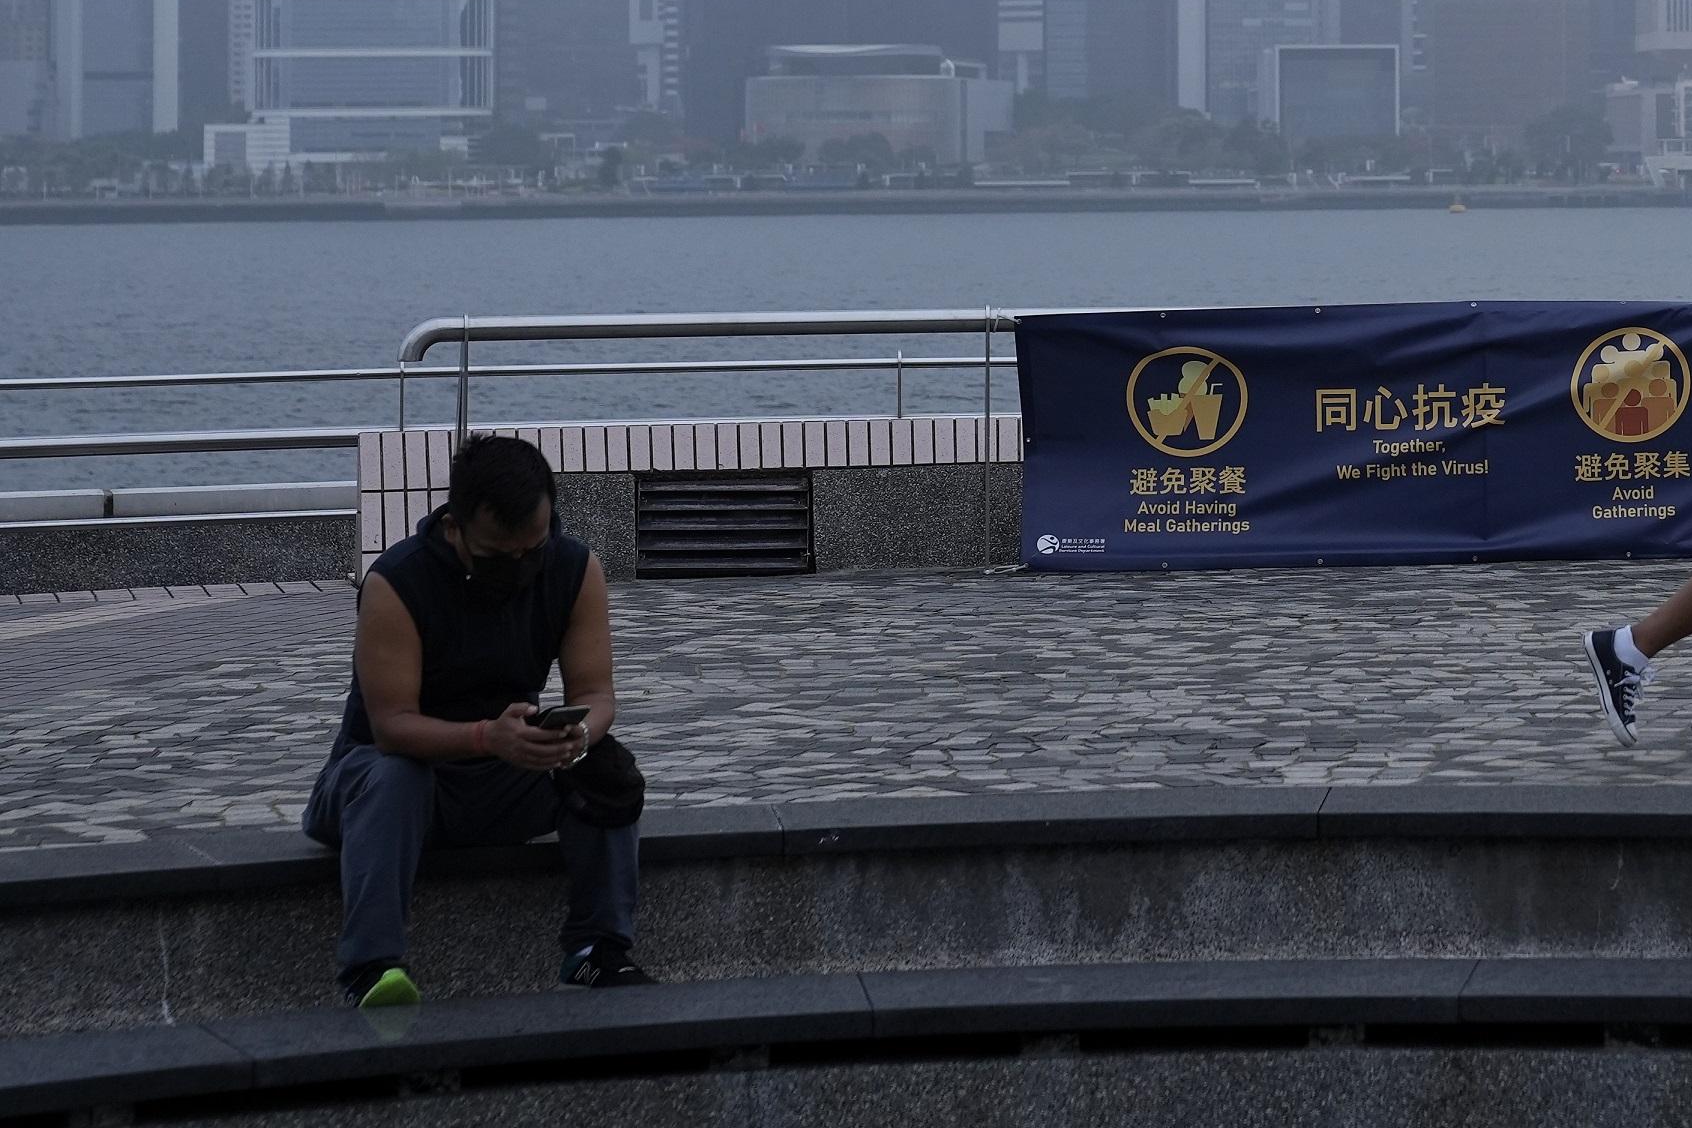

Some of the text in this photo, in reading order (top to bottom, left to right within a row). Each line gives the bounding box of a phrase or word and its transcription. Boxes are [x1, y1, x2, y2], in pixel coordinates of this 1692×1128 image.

[1315, 382, 1506, 433] 同心抗疫
[1372, 438, 1446, 457] Together,
[1336, 459, 1489, 481] We Fight the Virus!
[1574, 450, 1691, 482] 避免聚集
[1129, 465, 1247, 495] 避免聚餐
[1612, 485, 1654, 501] Avoid
[1137, 500, 1237, 517] Avoid Having
[1592, 503, 1676, 520] Gatherings
[1123, 518, 1250, 535] Meal Gatherings
